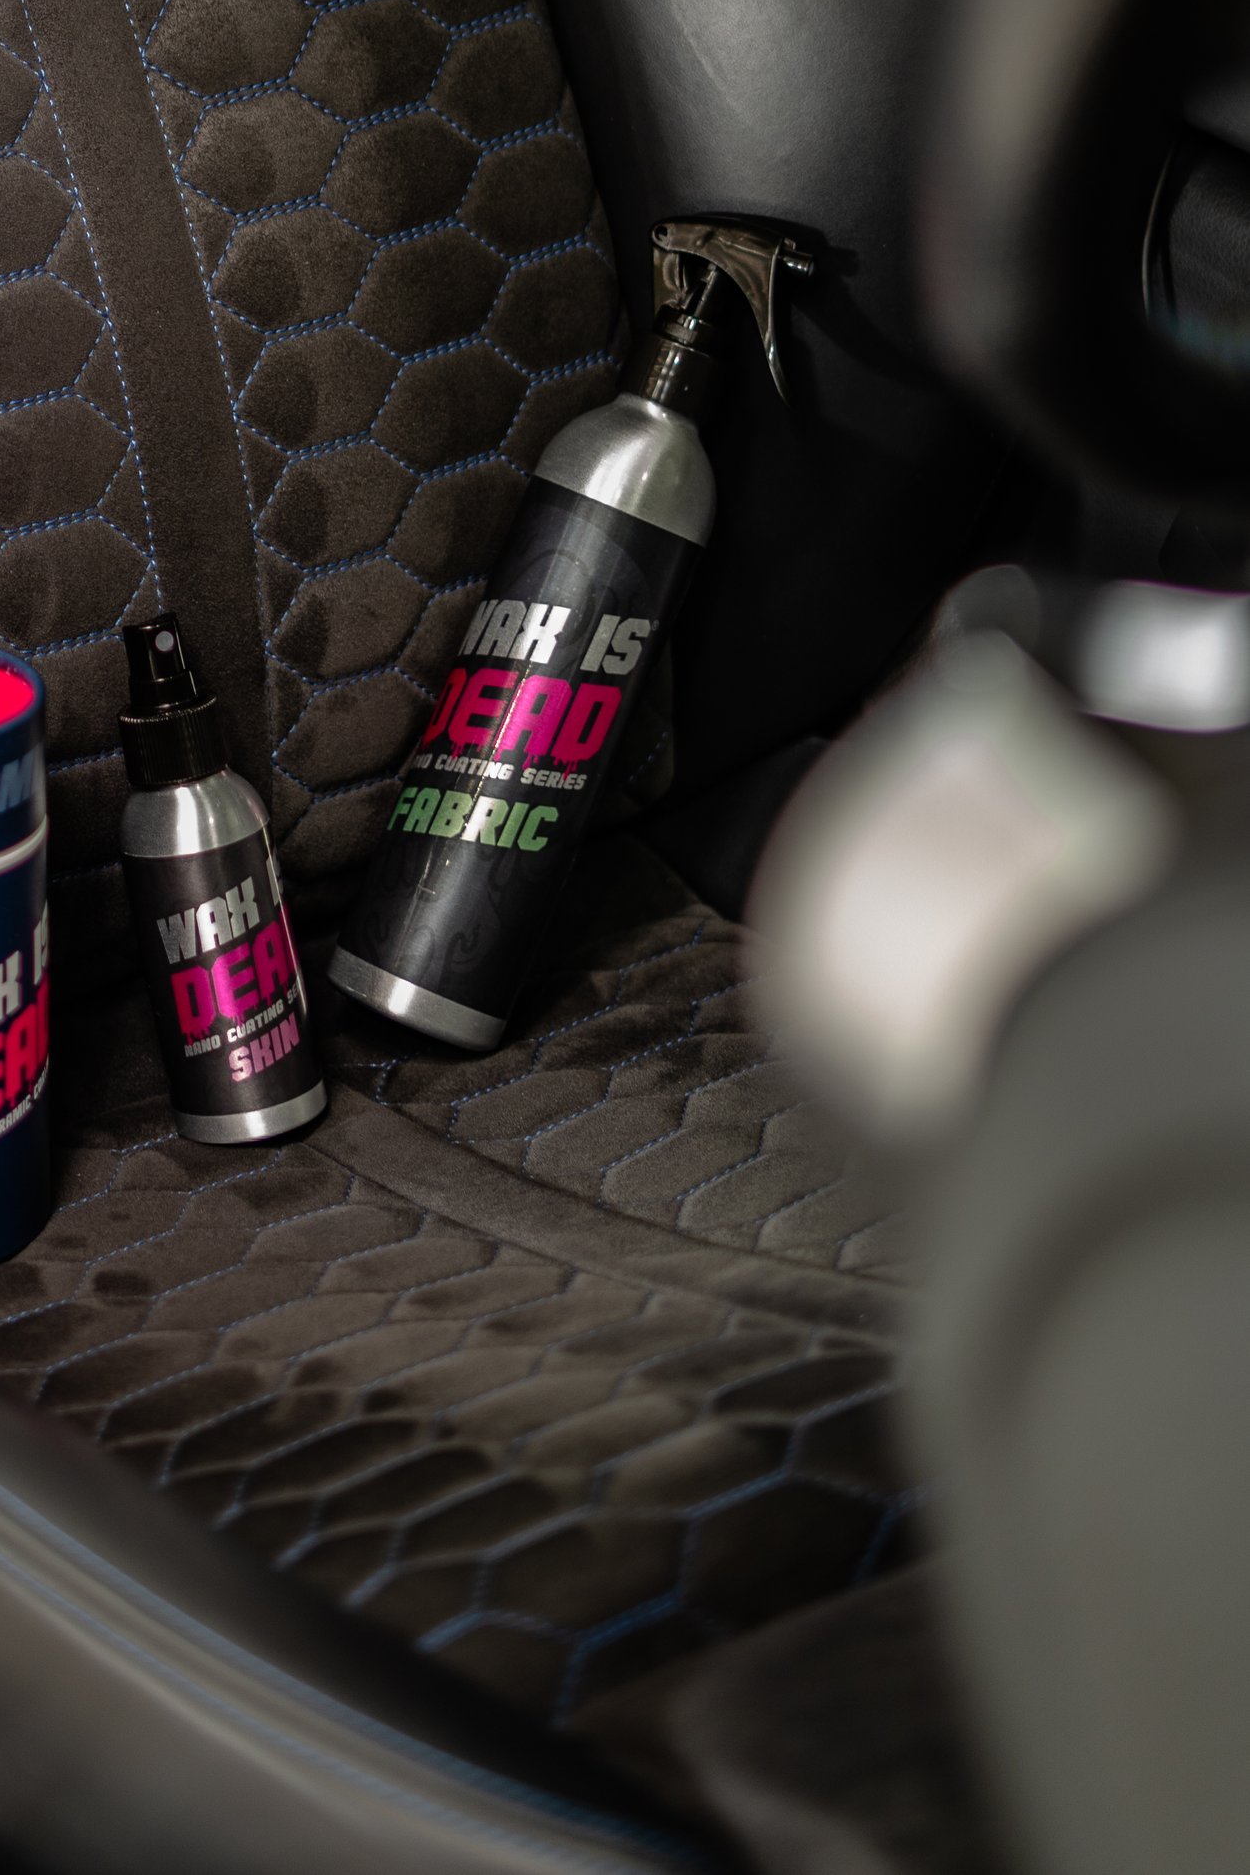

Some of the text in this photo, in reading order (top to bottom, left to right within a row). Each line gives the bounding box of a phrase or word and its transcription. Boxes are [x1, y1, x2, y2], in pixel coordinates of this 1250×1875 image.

[580, 613, 652, 676] IS
[520, 768, 588, 791] SERIES
[387, 786, 560, 852] FABRIC
[156, 875, 261, 965] WAX
[183, 1034, 222, 1058] NANO
[228, 1011, 302, 1083] SKIN
